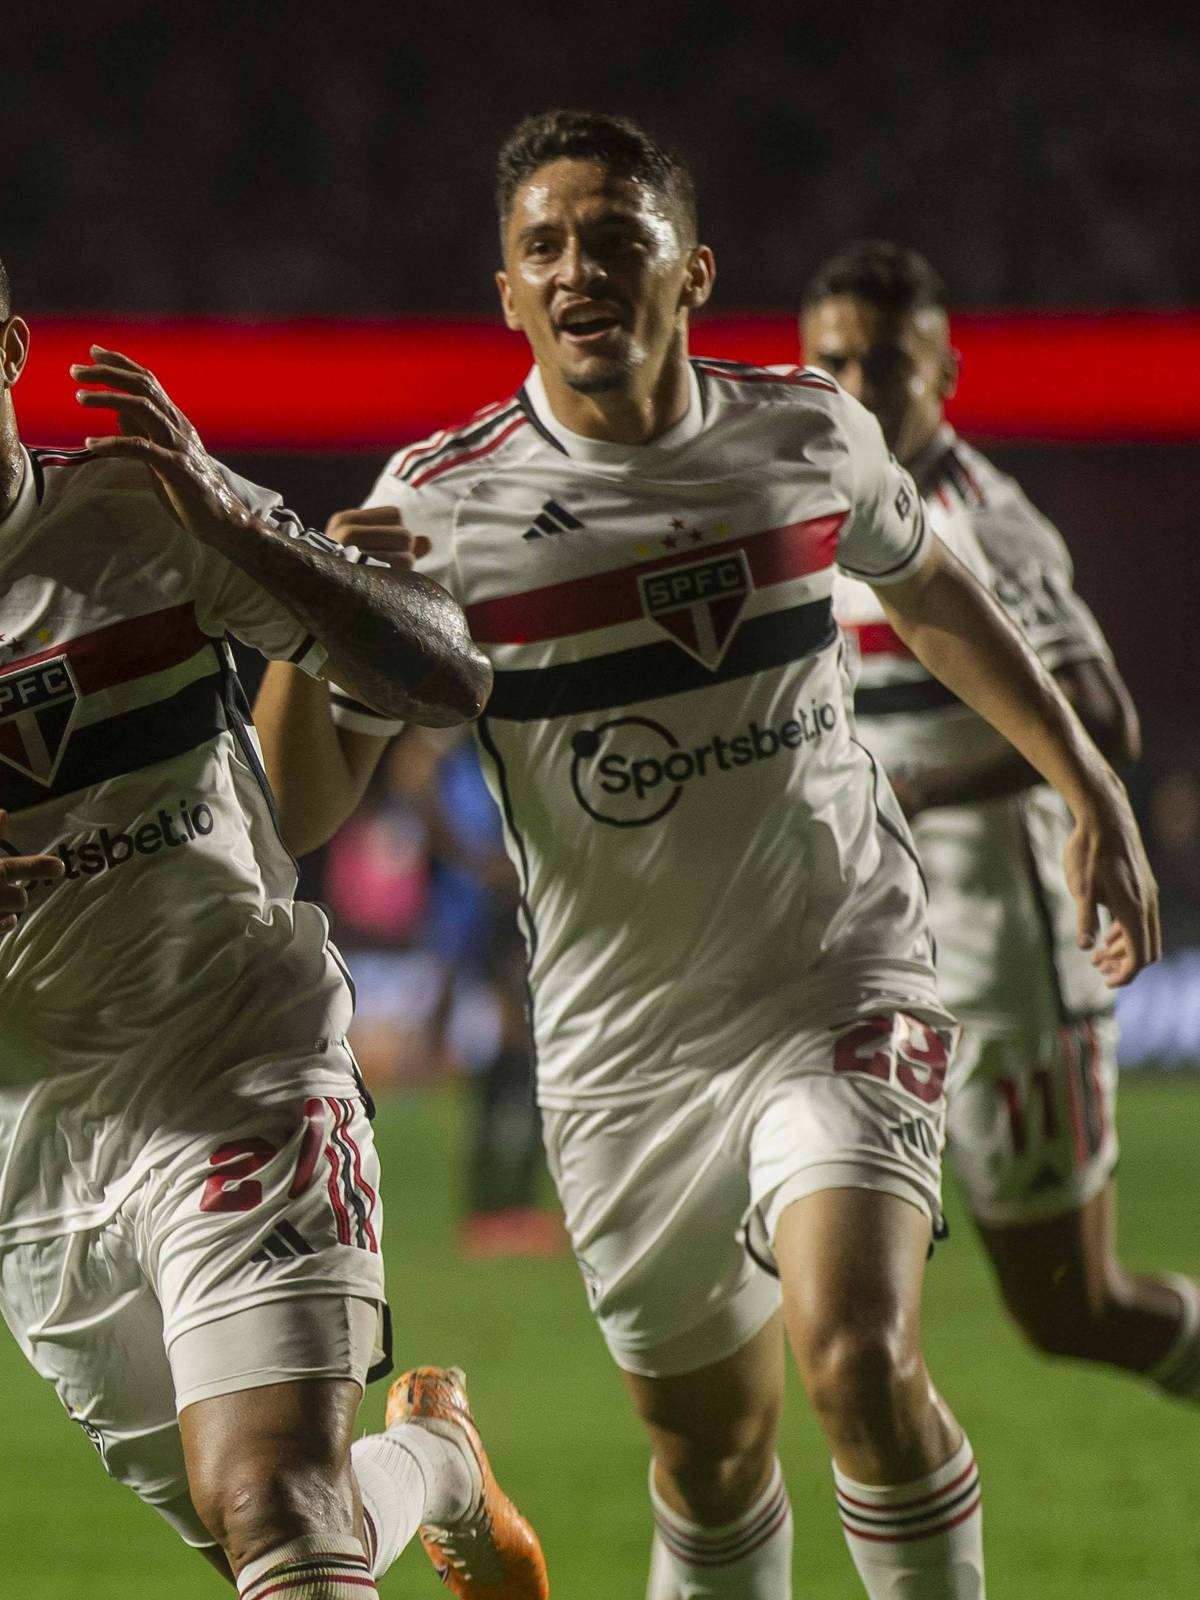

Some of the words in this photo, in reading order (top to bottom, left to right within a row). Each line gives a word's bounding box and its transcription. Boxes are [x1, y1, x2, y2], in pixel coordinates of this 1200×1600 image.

[648, 563, 740, 606] SPFC
[598, 699, 837, 799] Sportsbet.io
[28, 799, 214, 887] tsbet.io
[831, 1010, 948, 1104] 29
